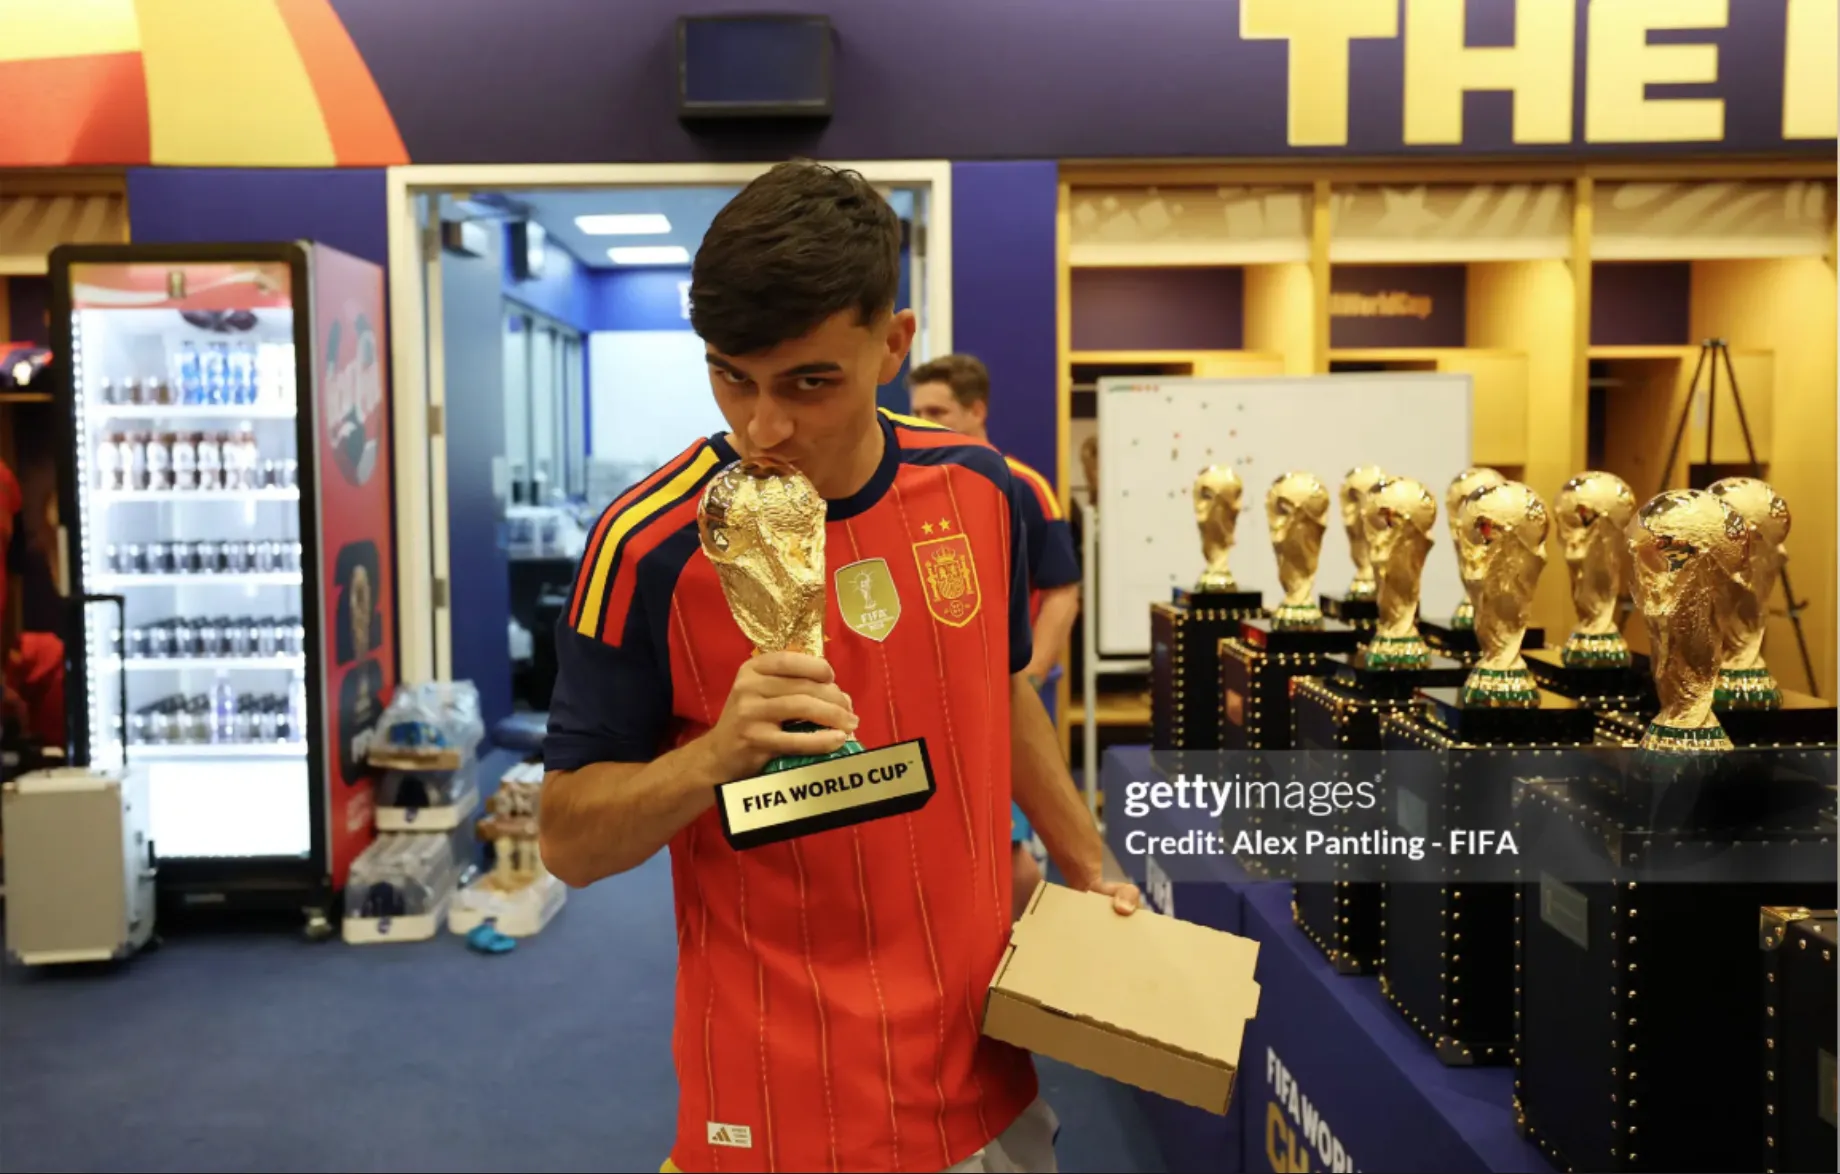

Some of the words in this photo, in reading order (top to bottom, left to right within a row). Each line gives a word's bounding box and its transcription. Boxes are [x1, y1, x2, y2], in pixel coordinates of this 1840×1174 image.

[1240, 0, 1729, 146] THE
[743, 790, 788, 812] FIFA
[789, 773, 864, 802] WORLD
[1267, 1045, 1301, 1126] FIFA
[1301, 1093, 1362, 1173] WOR
